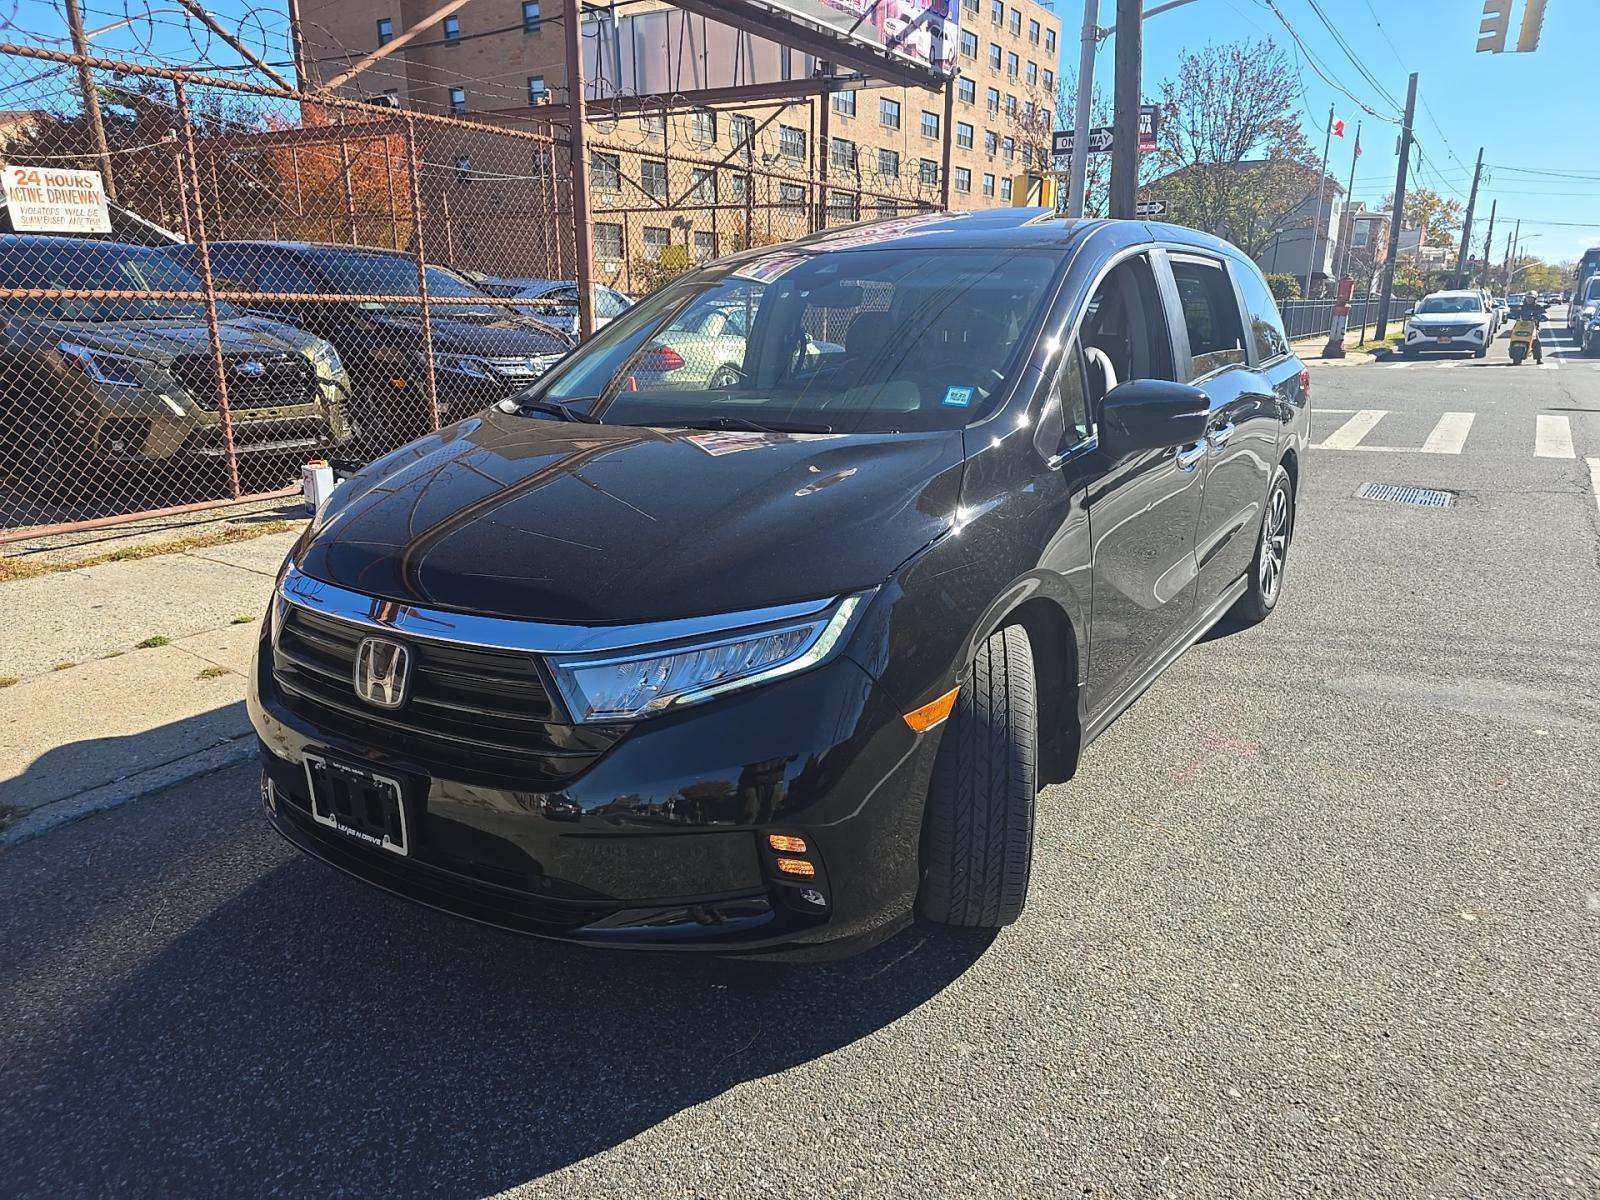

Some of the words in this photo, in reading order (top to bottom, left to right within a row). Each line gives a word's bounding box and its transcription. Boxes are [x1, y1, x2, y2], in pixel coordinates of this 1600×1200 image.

[1061, 137, 1075, 148] ON
[1089, 134, 1111, 146] WAY
[14, 169, 41, 186] 24
[44, 173, 93, 189] HOURS
[9, 186, 45, 203] ACTIVE
[46, 188, 100, 205] DRIVEWAY
[20, 206, 60, 216] VIOLATORS
[64, 207, 85, 217] WILL
[87, 208, 99, 217] BE
